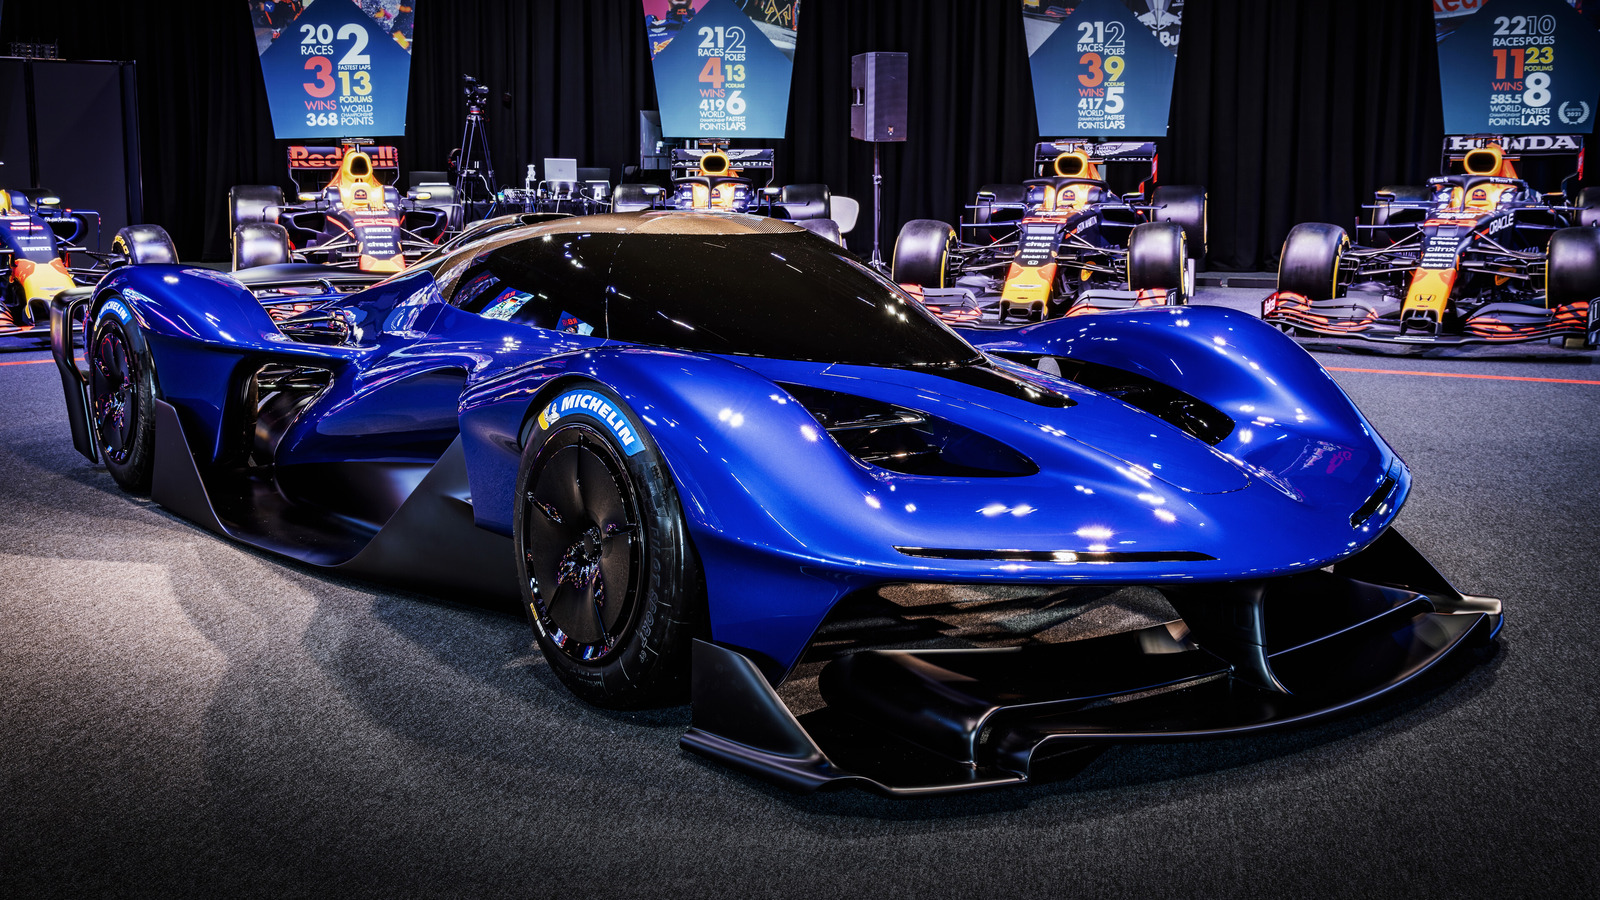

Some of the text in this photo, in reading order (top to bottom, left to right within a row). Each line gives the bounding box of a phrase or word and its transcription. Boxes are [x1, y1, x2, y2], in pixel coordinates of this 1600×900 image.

[1493, 15, 1527, 36] 22
[1527, 14, 1556, 36] 10
[300, 24, 334, 44] 20
[698, 26, 724, 48] 21
[725, 26, 746, 53] 2
[1077, 21, 1104, 44] 21
[1104, 21, 1125, 47] 2
[337, 23, 370, 64] 2
[1077, 43, 1104, 52] RACES
[1492, 35, 1556, 47] RACES POLES
[301, 45, 334, 55] RACES
[698, 48, 724, 57] RACES
[1525, 46, 1554, 64] 23
[1077, 52, 1104, 88] 3
[1104, 55, 1125, 82] 9
[1492, 48, 1525, 79] 11
[303, 56, 336, 98] 3
[698, 57, 725, 89] 4
[725, 64, 746, 82] 13
[338, 71, 372, 96] 13
[1491, 81, 1523, 92] WINS
[1523, 72, 1551, 108] 8
[699, 89, 726, 98] WINS
[1078, 88, 1104, 97] WINS
[1490, 94, 1522, 104] 585.5
[304, 100, 337, 110] WINS
[699, 99, 725, 111] 419
[725, 90, 746, 115] 6
[1077, 98, 1104, 110] 417
[1104, 87, 1125, 114] 5
[340, 104, 373, 113] WORLD
[1078, 109, 1104, 117] WORLD
[1489, 104, 1521, 113] WORLD
[1521, 107, 1551, 115] FASTEST
[306, 112, 338, 126] 368
[341, 117, 374, 126] POINTS
[1078, 121, 1104, 129] POINTS
[1104, 120, 1126, 130] LAPS
[1488, 117, 1521, 126] POINTS
[1521, 115, 1550, 126] LAPS
[699, 122, 726, 131] POINTS
[726, 122, 746, 131] LAPS
[290, 146, 342, 167] Red
[1489, 213, 1514, 235] ORACLE
[560, 394, 635, 446] MICHELIN
